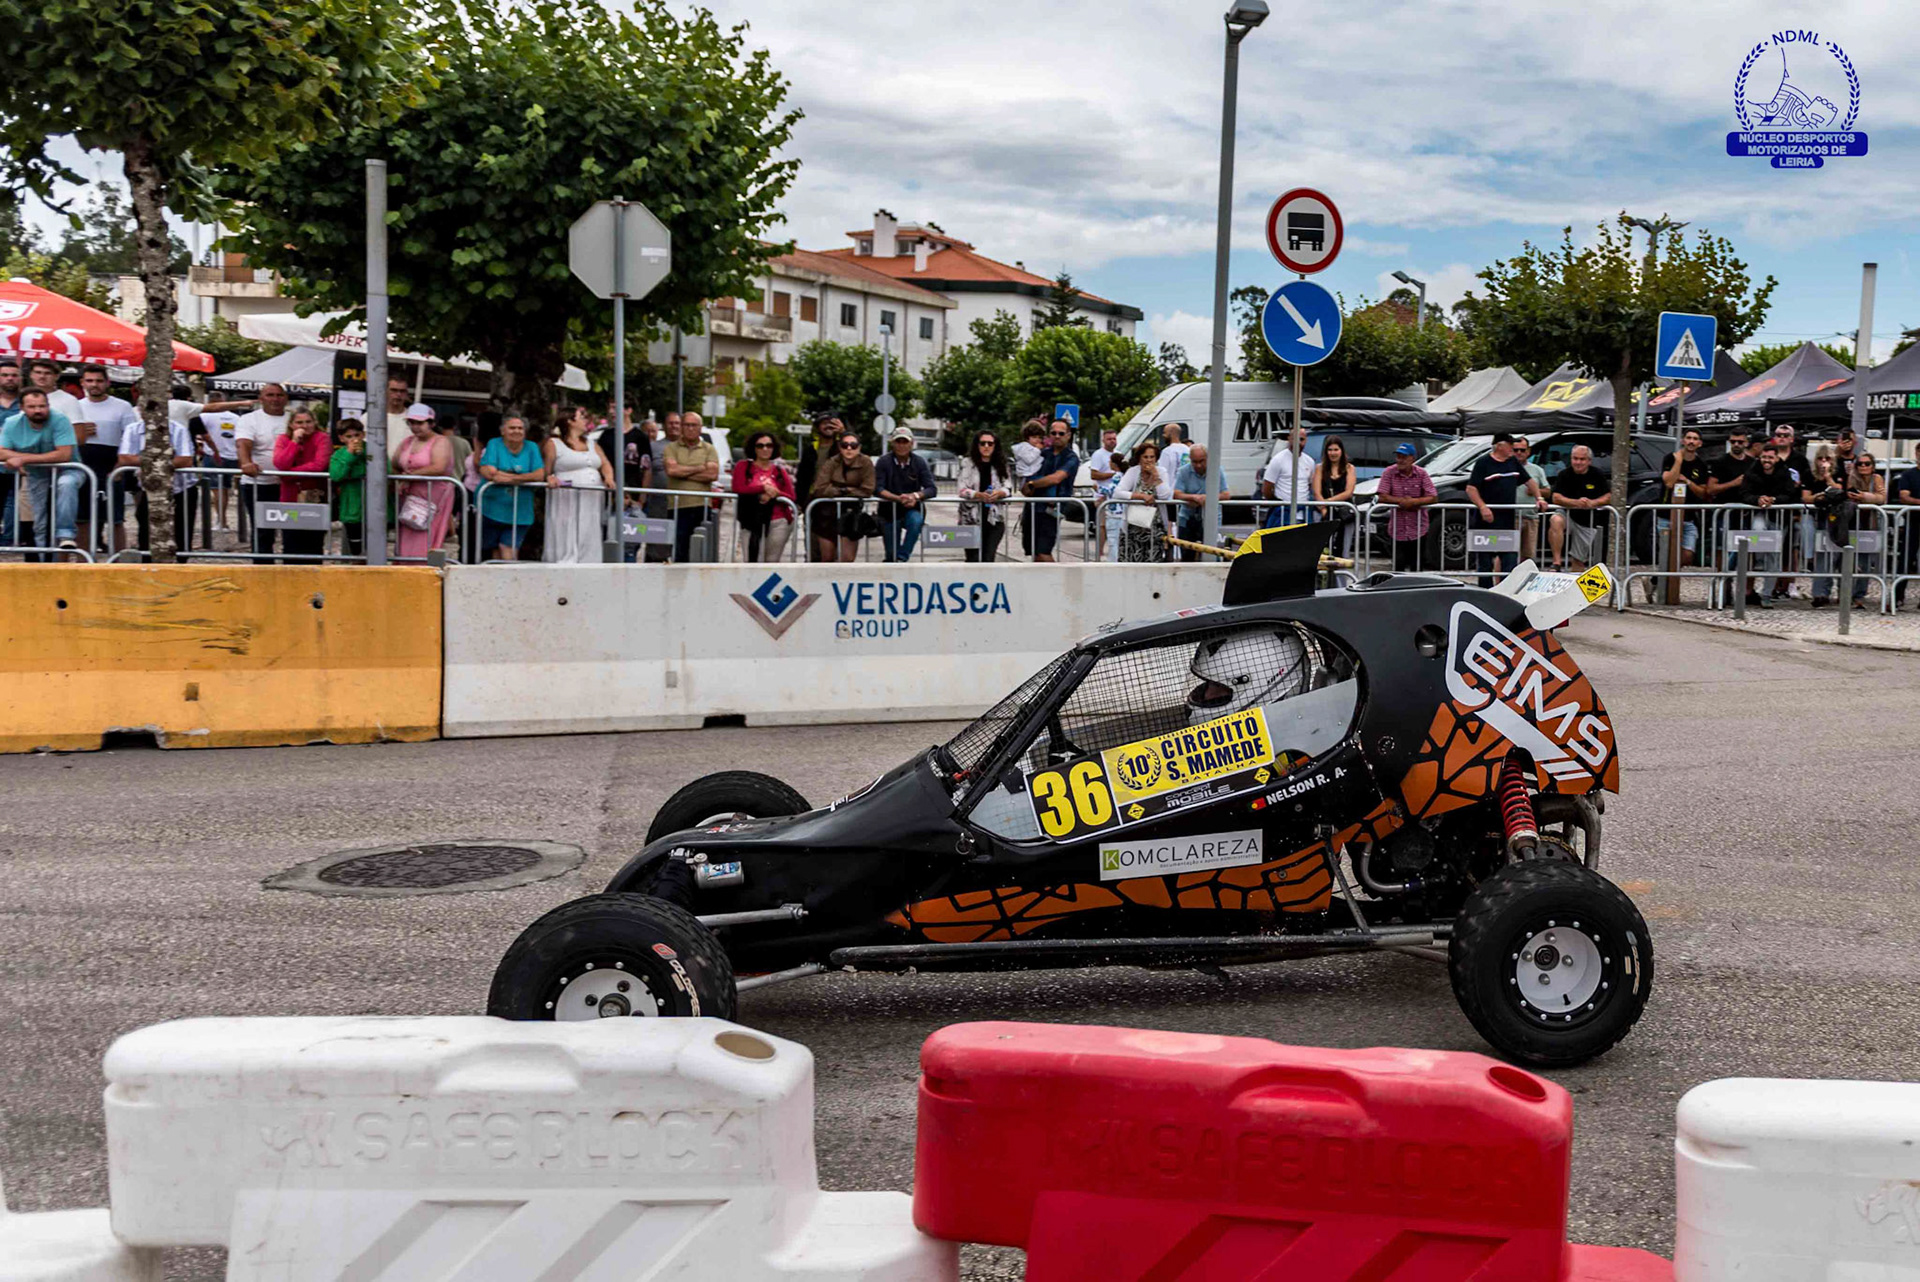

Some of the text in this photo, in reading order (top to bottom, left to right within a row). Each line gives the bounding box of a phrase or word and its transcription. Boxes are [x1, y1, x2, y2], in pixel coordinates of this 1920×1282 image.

[831, 582, 1011, 615] VERDASCA
[835, 619, 909, 638] GROUP
[1161, 716, 1259, 760] CIRCUITO
[1167, 737, 1265, 781] S. MAMEDE
[1182, 759, 1257, 784] BATALHA
[1032, 761, 1112, 837] 36
[1266, 778, 1316, 805] NELSON
[1316, 774, 1330, 786] R.
[1104, 838, 1259, 869] KOMCLAREZA
